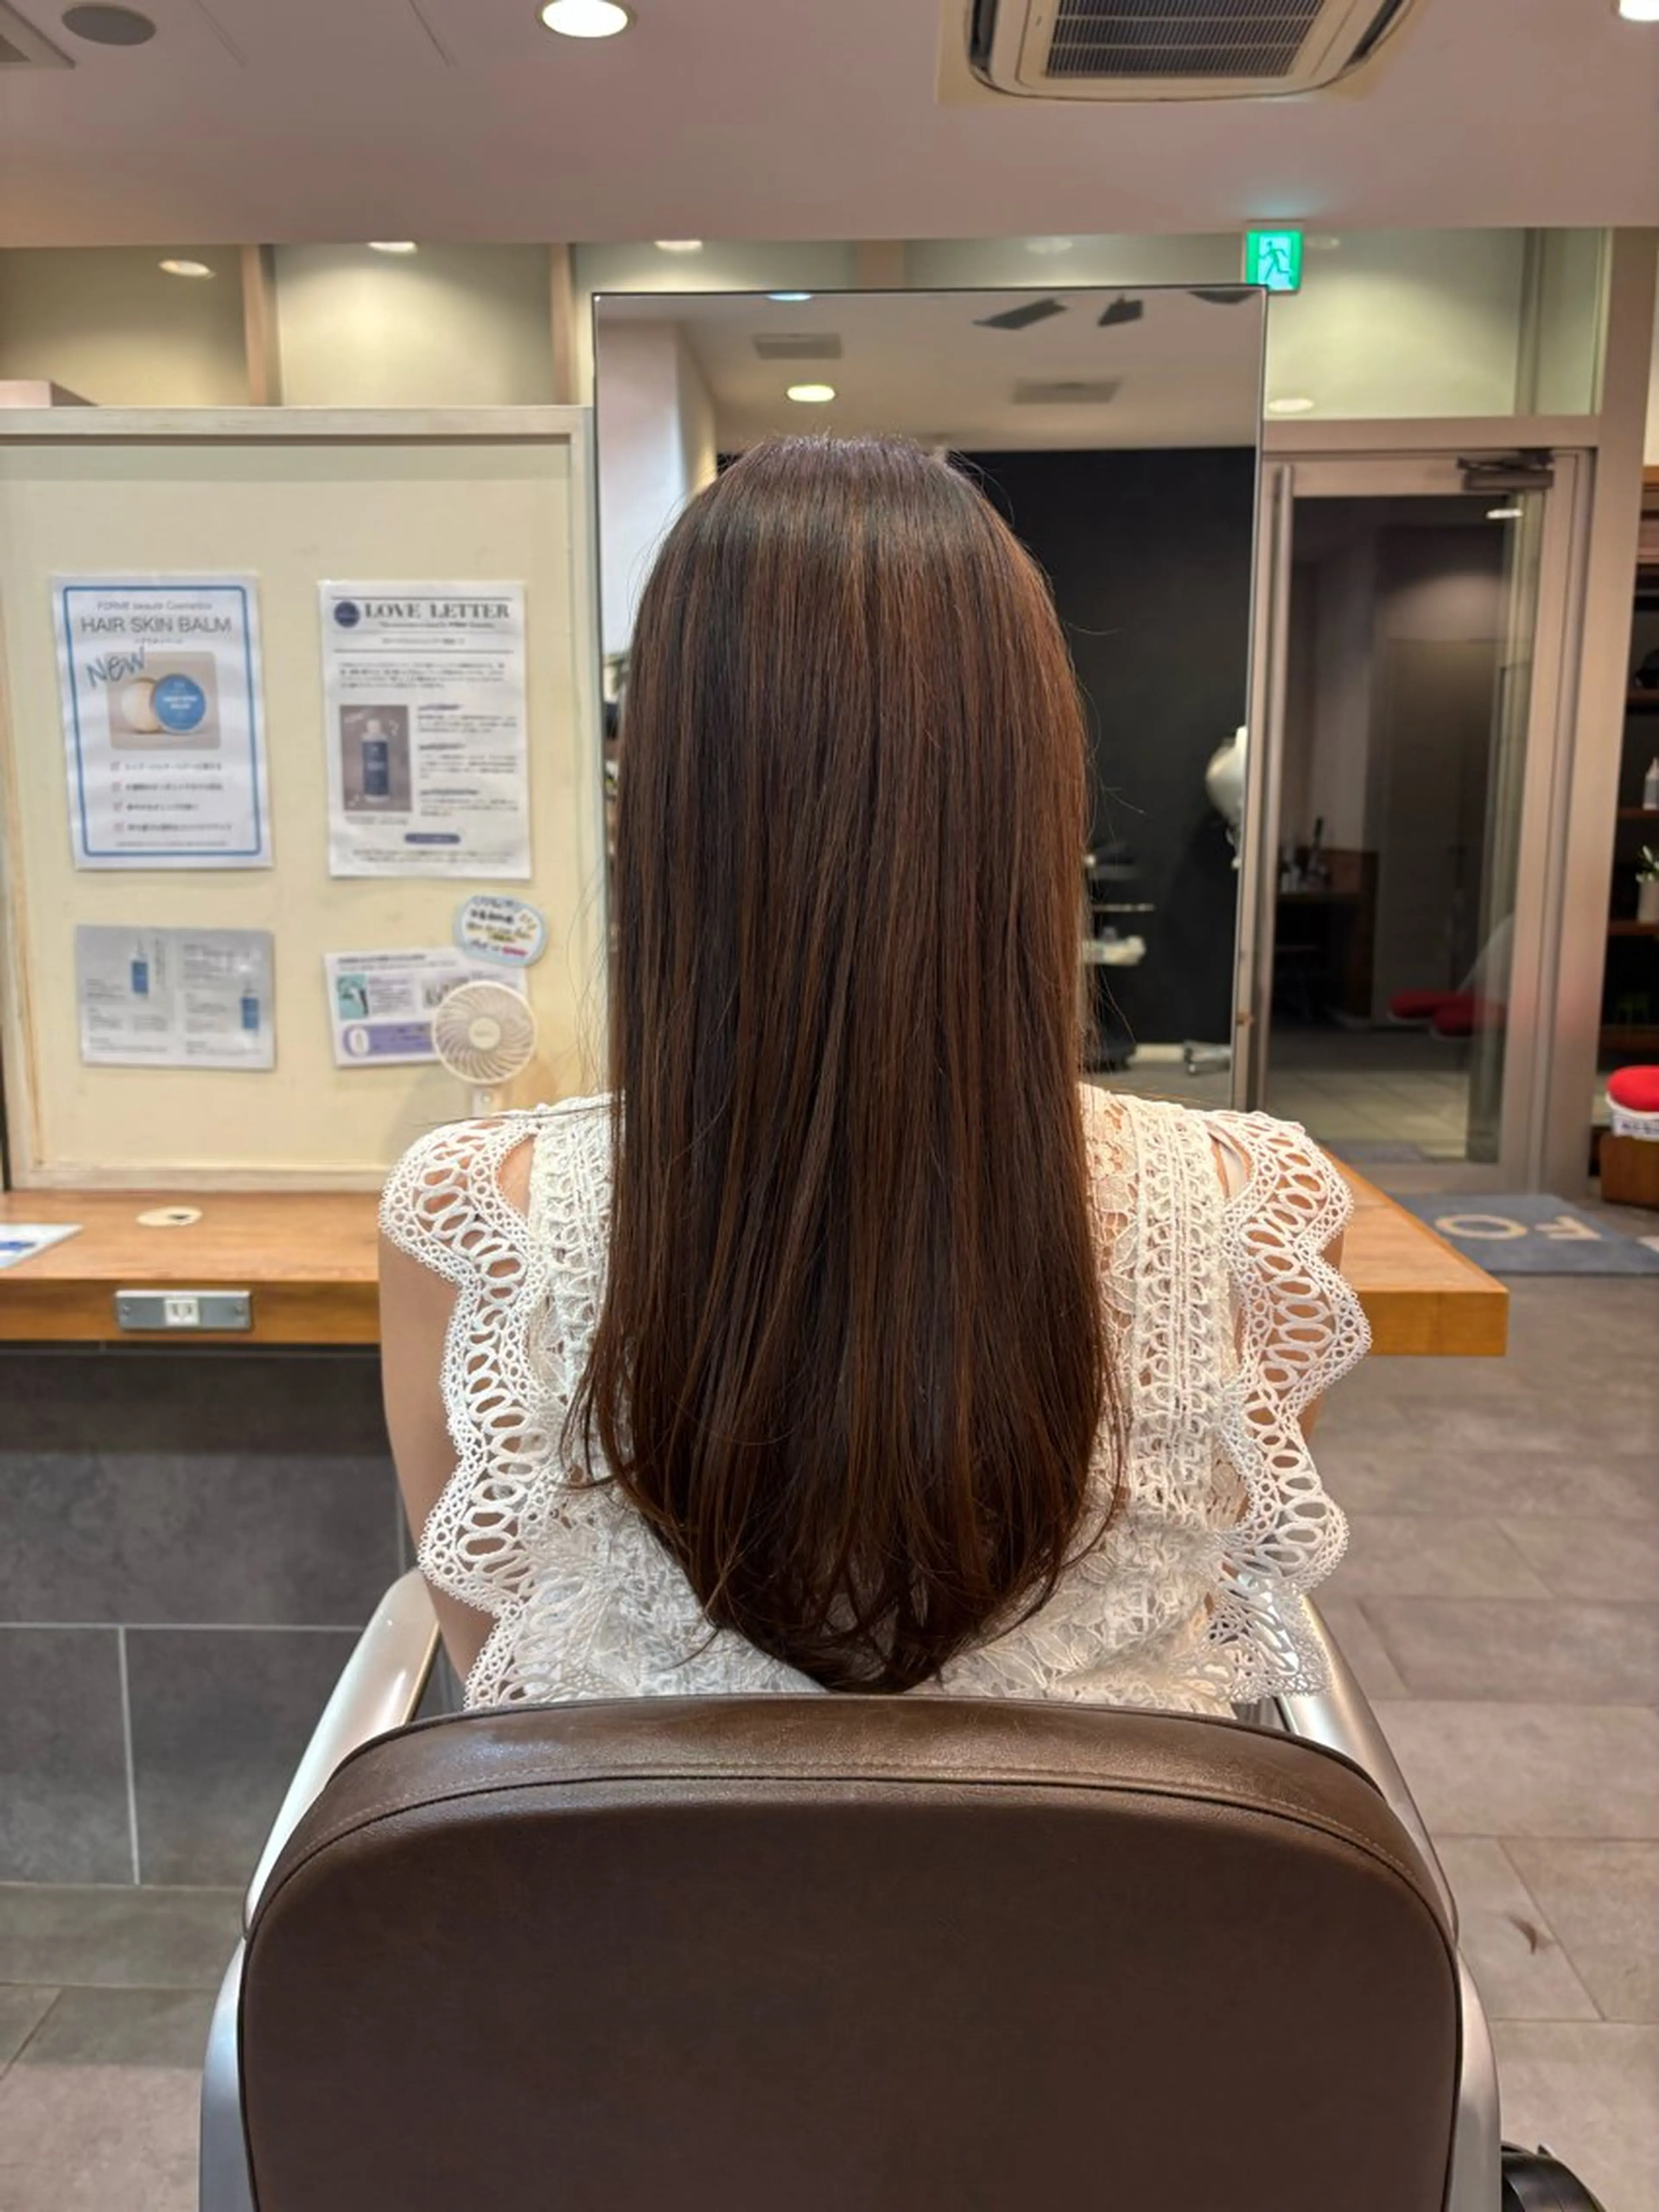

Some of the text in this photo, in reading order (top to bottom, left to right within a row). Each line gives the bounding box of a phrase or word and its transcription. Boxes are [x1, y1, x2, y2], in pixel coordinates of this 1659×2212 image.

[365, 603, 510, 618] LOVE LETTER
[81, 616, 232, 634] HAIR SKIN BALM
